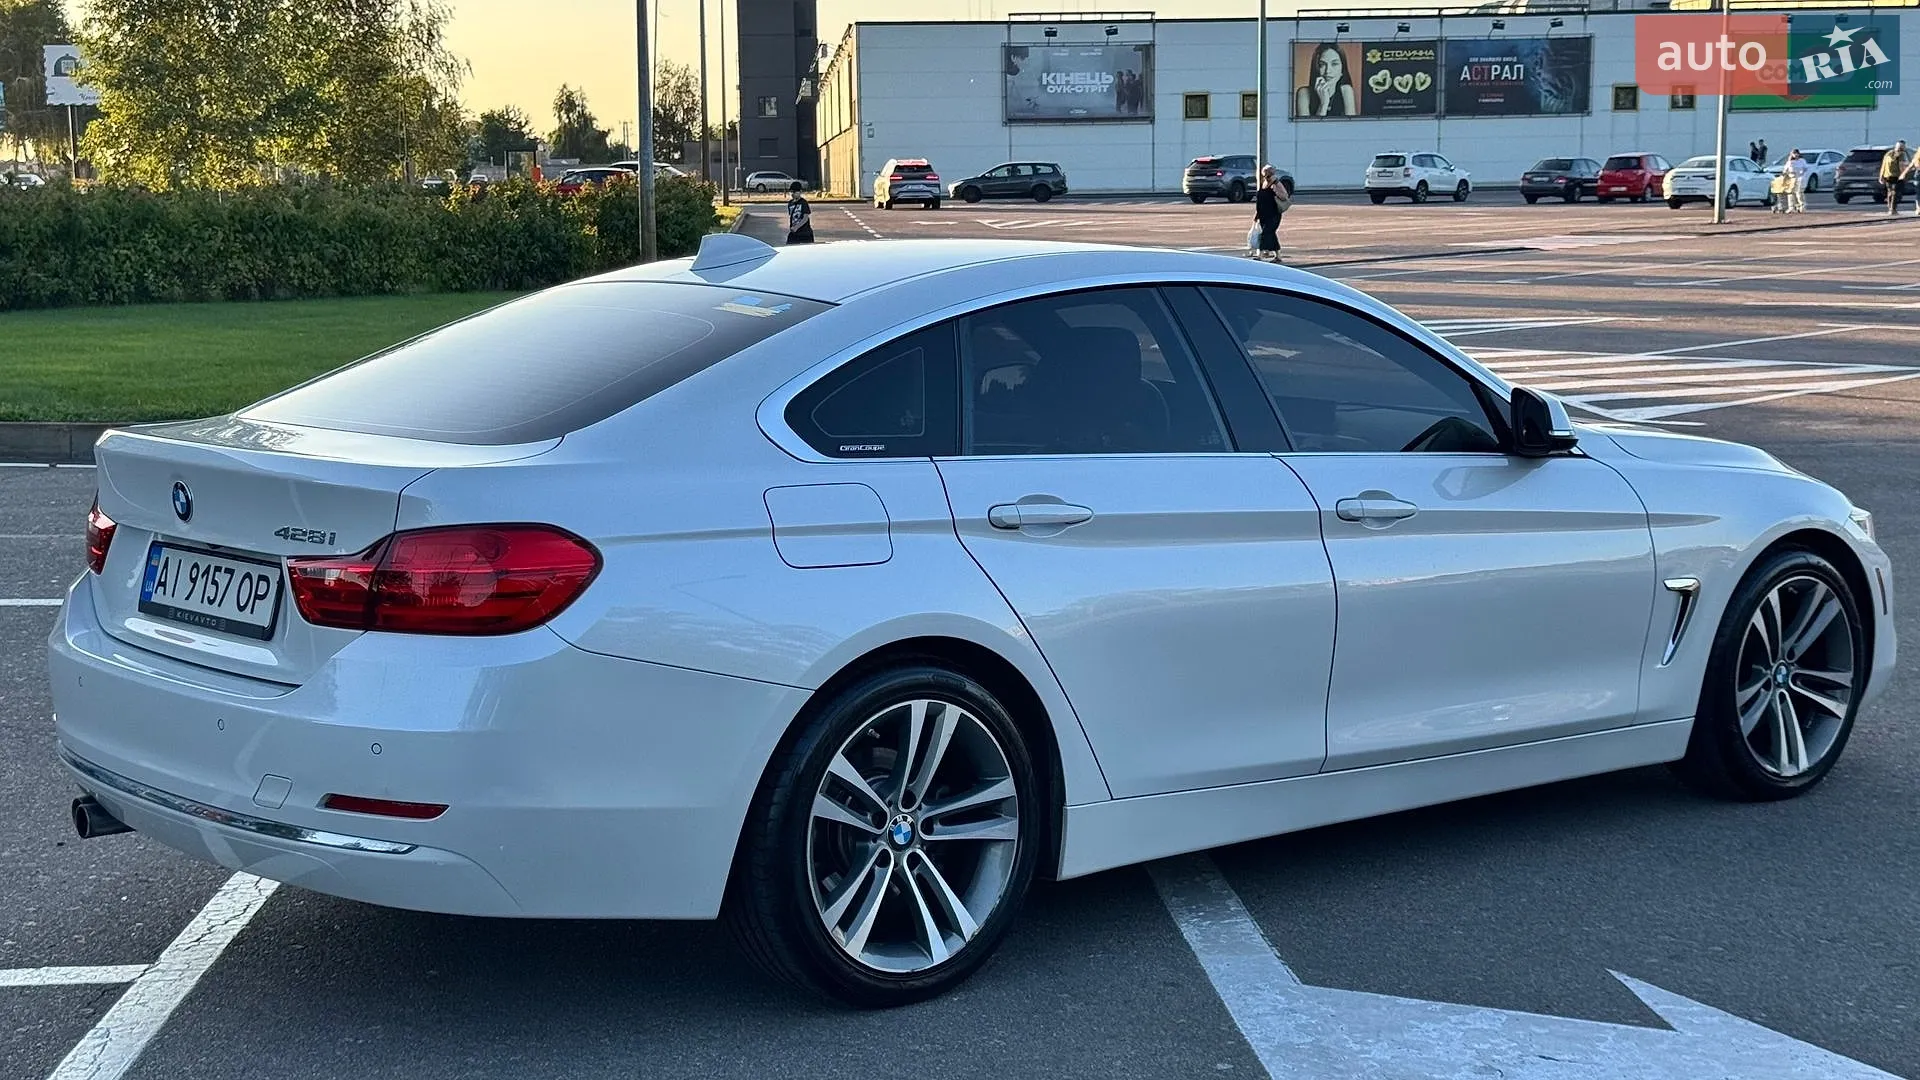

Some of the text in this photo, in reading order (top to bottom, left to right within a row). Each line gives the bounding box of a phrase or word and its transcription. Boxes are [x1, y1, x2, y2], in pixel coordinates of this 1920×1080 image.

[1042, 72, 1114, 86] КІНЕЦЬ
[1460, 64, 1524, 81] АСТРАЛ
[274, 526, 337, 546] 428i
[154, 556, 271, 615] AI 9157 OP
[176, 612, 218, 627] KIEVAVTO
